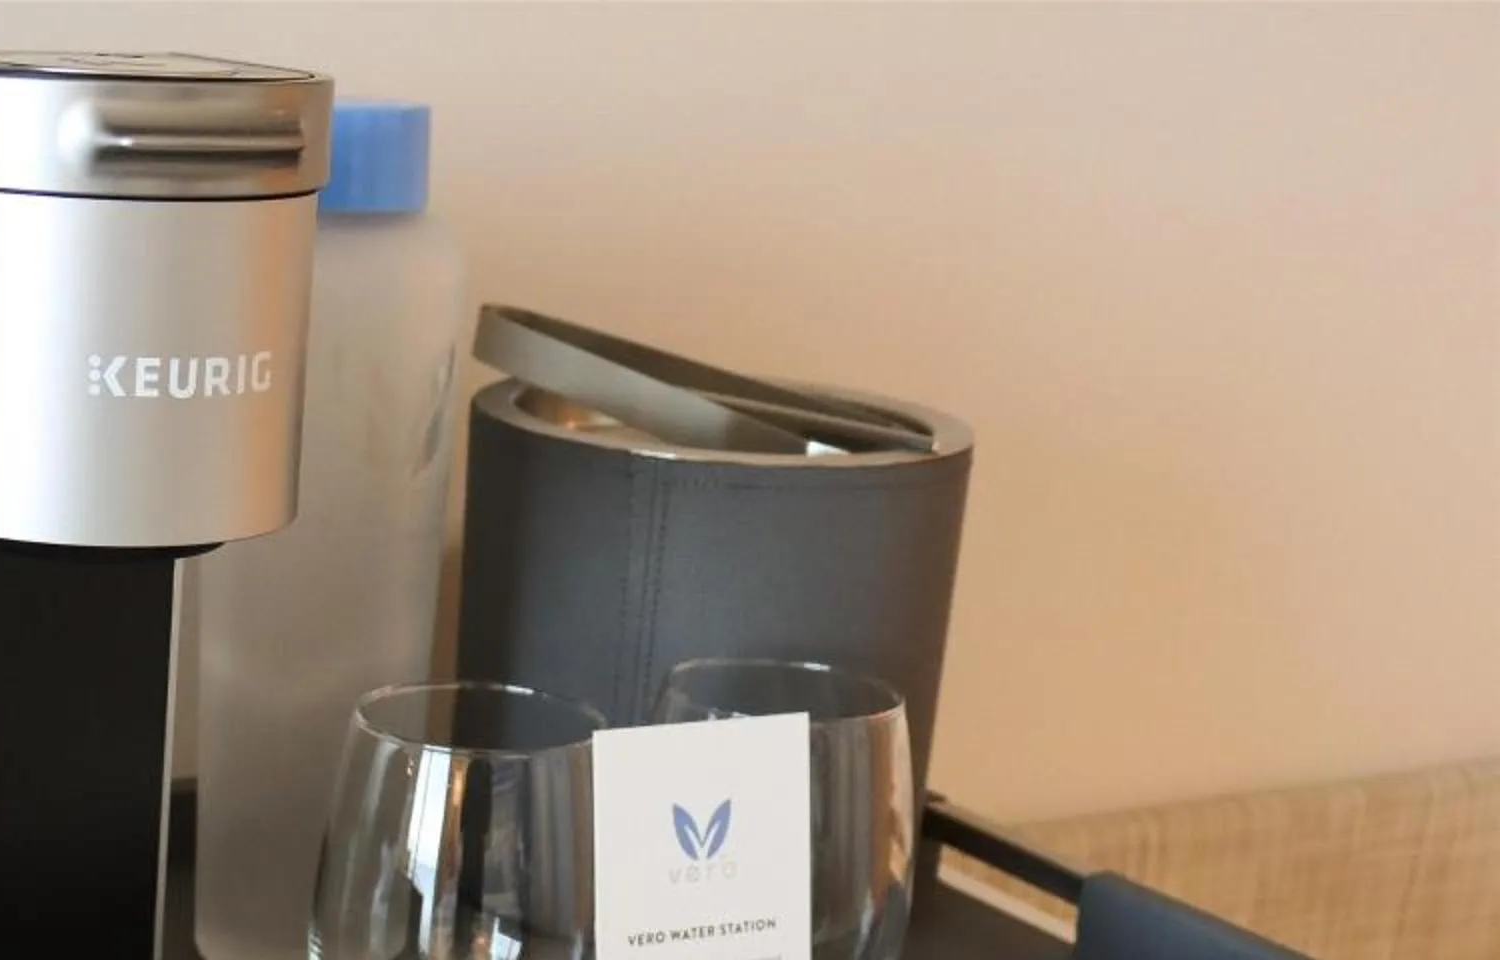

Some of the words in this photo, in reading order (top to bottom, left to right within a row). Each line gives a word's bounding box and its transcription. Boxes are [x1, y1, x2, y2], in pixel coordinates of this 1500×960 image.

[87, 351, 272, 399] KEURIG
[627, 932, 666, 948] VERO
[671, 925, 717, 942] WATER
[720, 917, 777, 936] STATION
